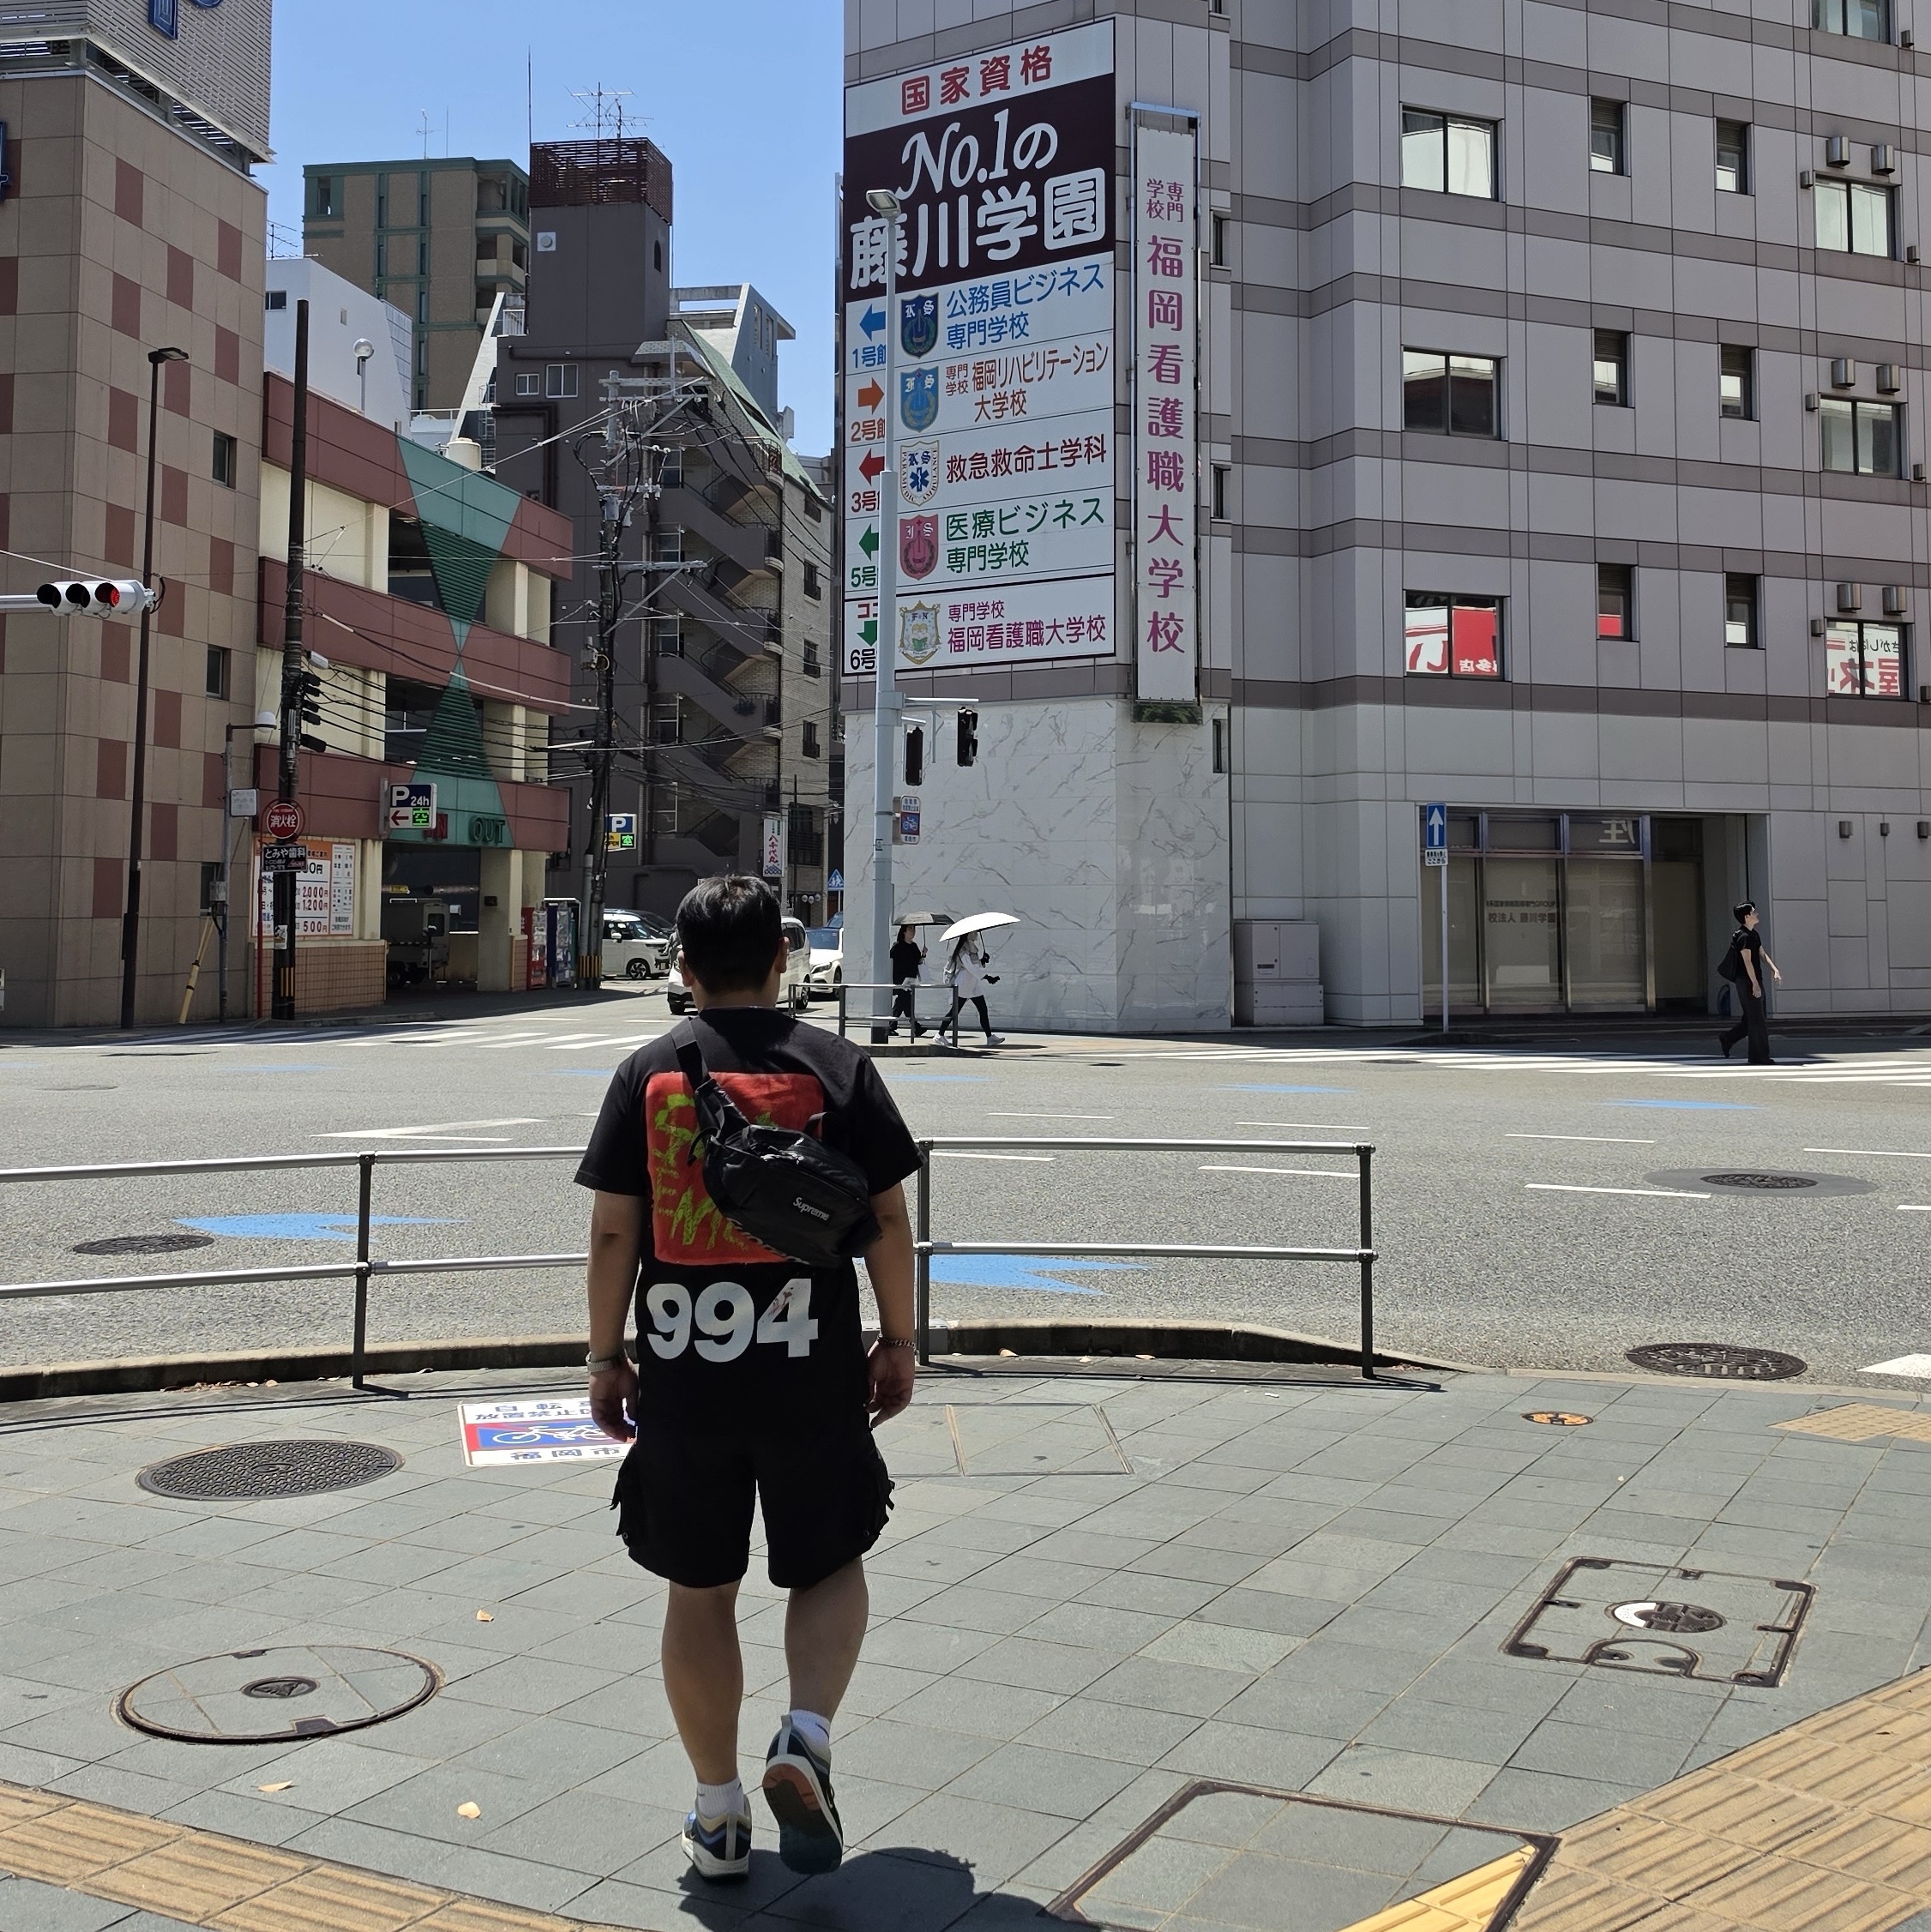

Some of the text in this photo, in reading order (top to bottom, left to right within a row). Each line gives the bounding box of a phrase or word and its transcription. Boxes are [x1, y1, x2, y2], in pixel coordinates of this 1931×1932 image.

[901, 45, 1052, 115] 国家資格
[896, 108, 1058, 201] No.1の
[1146, 178, 1164, 221] 学校
[1166, 180, 1183, 223] 専門
[851, 167, 1105, 290] 藤川学園
[947, 263, 1104, 319] 公務員ビジネス
[947, 311, 1030, 350] 専門学校
[946, 363, 968, 382] 専門
[972, 342, 1109, 391] 福岡リハビリテーション
[946, 378, 969, 397] 学校
[974, 388, 1027, 423] 大学校
[947, 433, 1107, 484] 救急救命士学科
[1146, 234, 1185, 653] 福岡看護職大学校
[851, 491, 880, 513] 3号
[946, 497, 1104, 543] 医療ビジネス
[947, 539, 1030, 574] 専門学校
[851, 565, 878, 588] 5号
[947, 599, 1005, 623] 専門学校
[947, 614, 1106, 653] 福岡看護職大学校
[850, 648, 877, 671] 6号
[411, 796, 430, 806] 24h
[270, 815, 297, 828] 消火栓
[470, 816, 505, 843] OUT
[265, 847, 306, 858] とみや歯科
[793, 1197, 830, 1221] Supreme
[646, 1277, 819, 1363] 994
[510, 1447, 621, 1460] 福岡市
